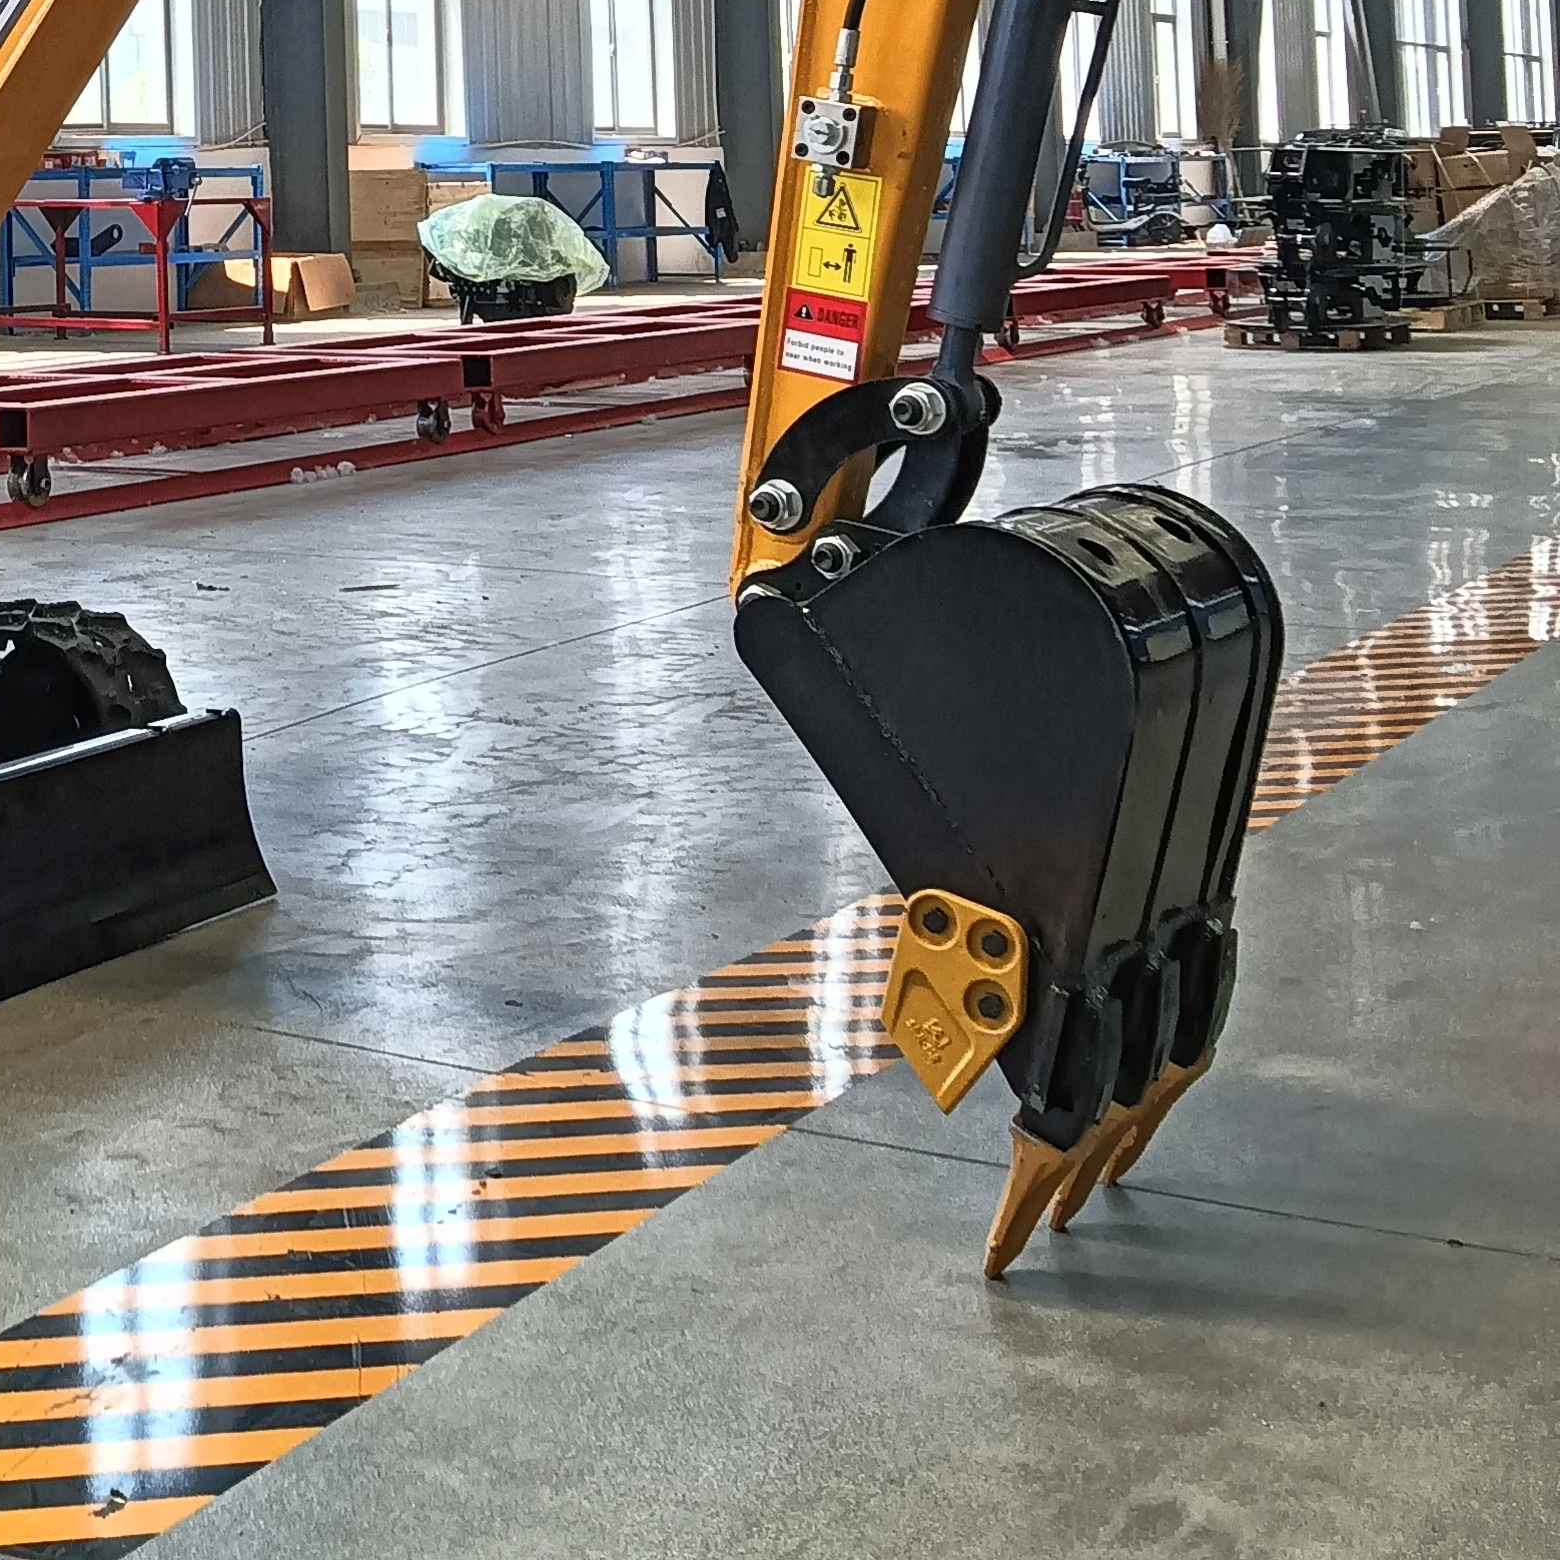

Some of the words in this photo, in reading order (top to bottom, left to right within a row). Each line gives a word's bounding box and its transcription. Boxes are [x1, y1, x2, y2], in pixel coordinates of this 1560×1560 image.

[817, 307, 859, 329] DANGER
[787, 337, 809, 349] Forbid
[811, 344, 834, 354] people
[837, 349, 845, 357] to
[785, 351, 800, 359] near
[803, 355, 821, 364] when
[824, 360, 852, 372] working
